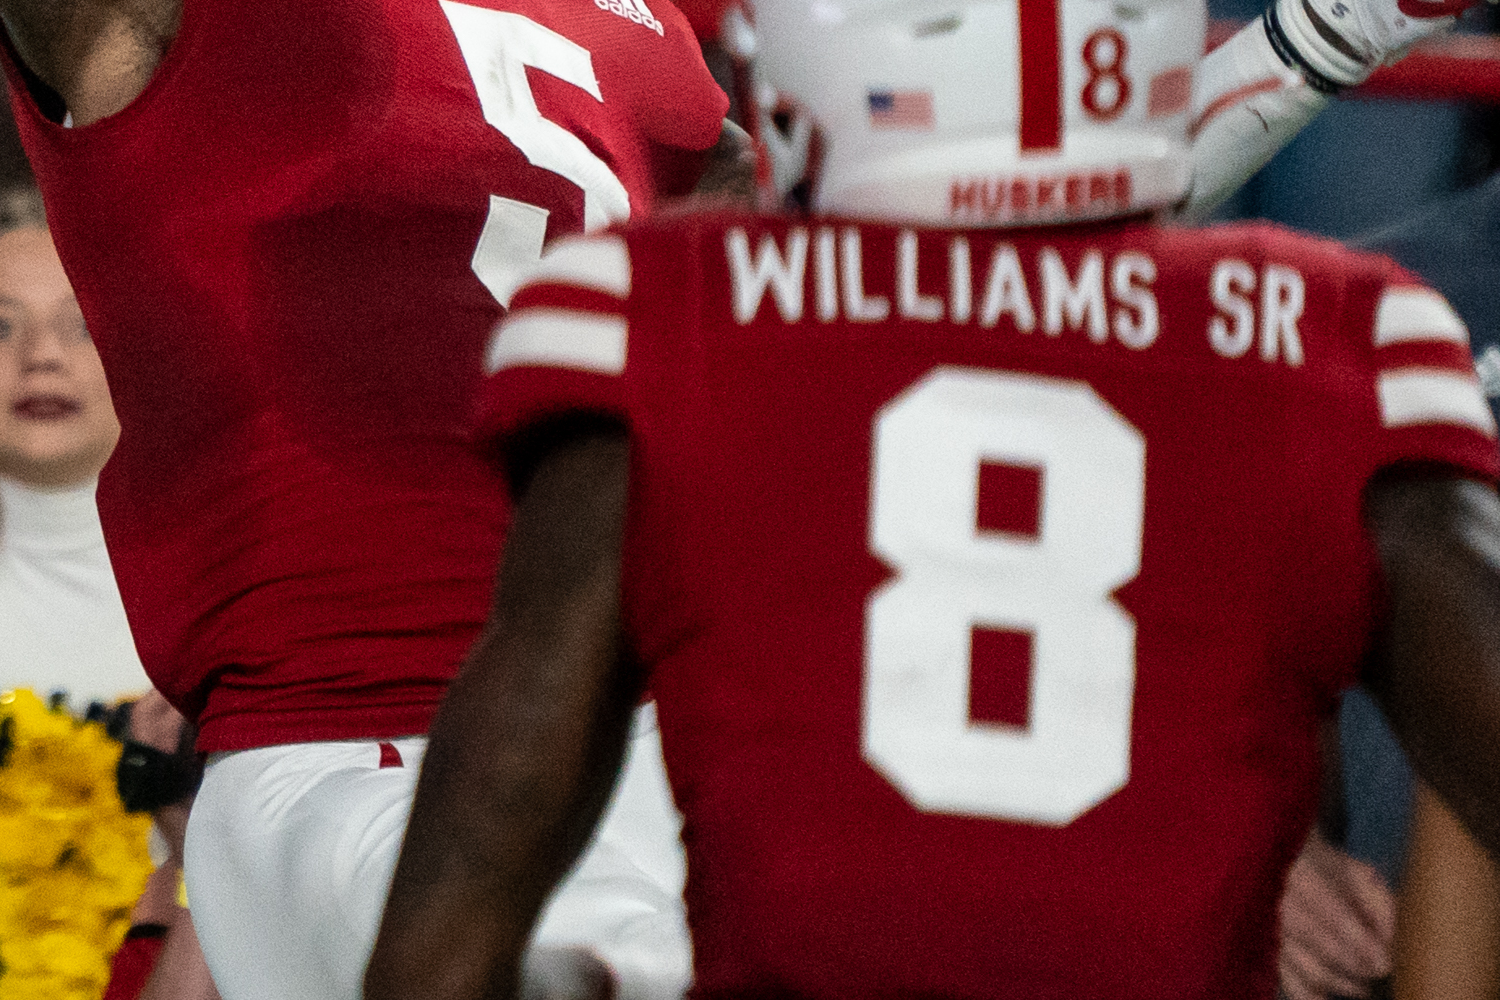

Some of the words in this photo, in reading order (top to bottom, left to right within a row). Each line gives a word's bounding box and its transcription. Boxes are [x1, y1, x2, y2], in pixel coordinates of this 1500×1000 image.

[1082, 27, 1133, 124] 8
[949, 165, 1132, 216] HUSKERS
[724, 226, 1160, 350] WILLIAMS
[1206, 258, 1306, 366] SR
[861, 364, 1146, 826] 8
